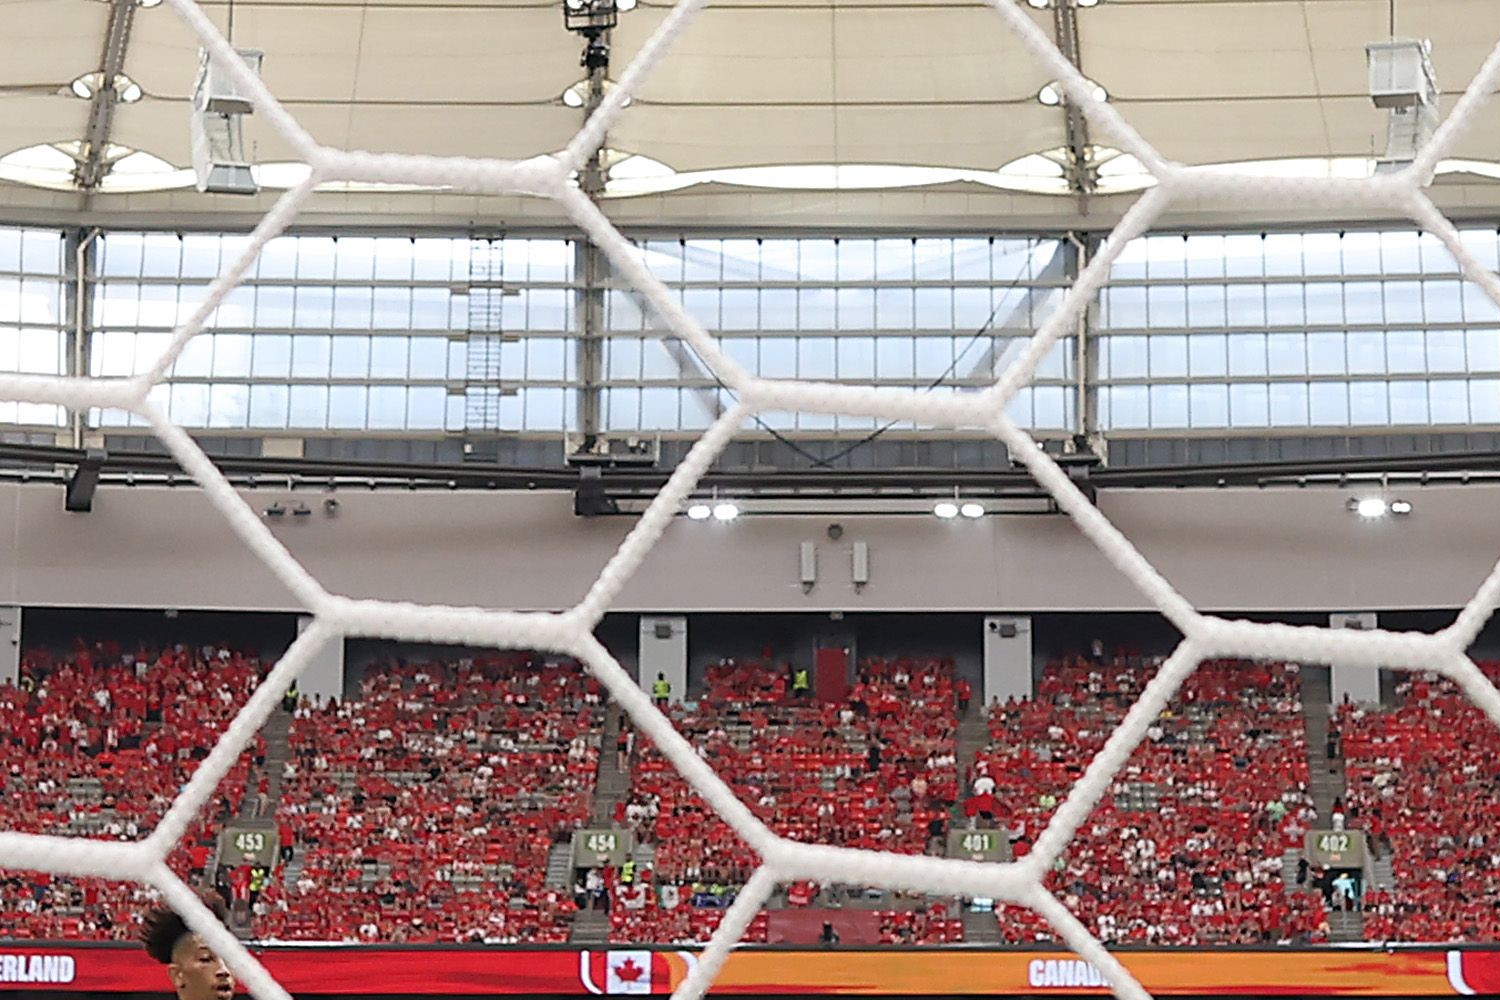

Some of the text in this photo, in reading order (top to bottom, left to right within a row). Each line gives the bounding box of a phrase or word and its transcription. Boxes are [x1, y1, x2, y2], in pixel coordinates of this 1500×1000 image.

[235, 833, 264, 850] 453
[587, 833, 616, 852] 454
[962, 833, 990, 851] 401
[1319, 834, 1349, 852] 402
[0, 954, 75, 983] RLAND
